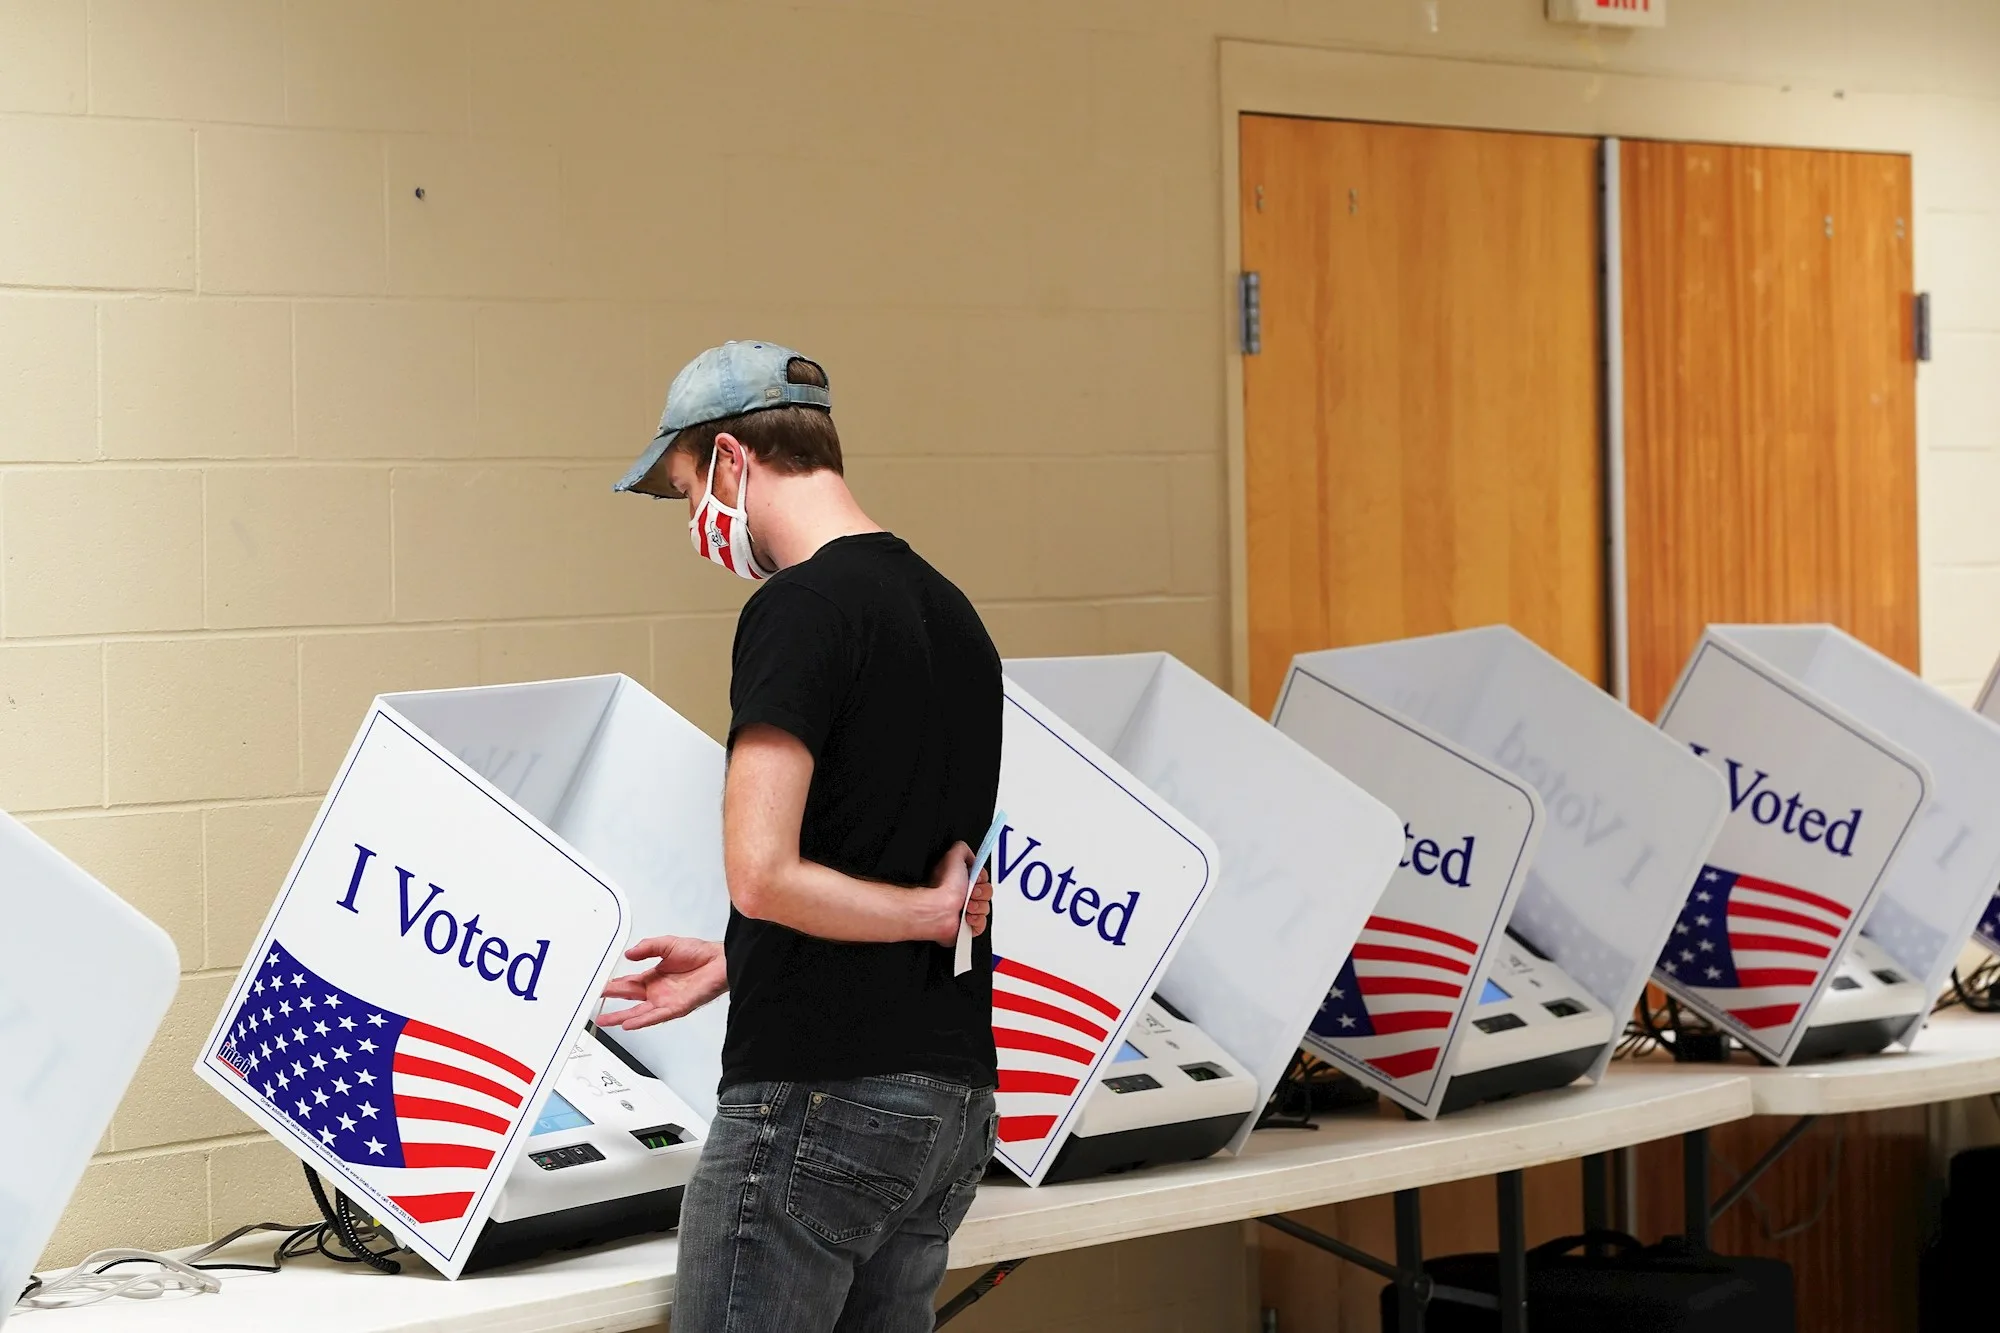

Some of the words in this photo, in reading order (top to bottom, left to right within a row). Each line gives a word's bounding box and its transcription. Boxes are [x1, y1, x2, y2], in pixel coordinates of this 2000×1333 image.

[1725, 758, 1863, 857] Voted
[998, 824, 1141, 946] Voted
[1399, 822, 1475, 888] ted
[336, 843, 377, 914] I
[395, 865, 550, 1001] Voted
[218, 1041, 251, 1076] intab
[260, 1097, 272, 1108] Order
